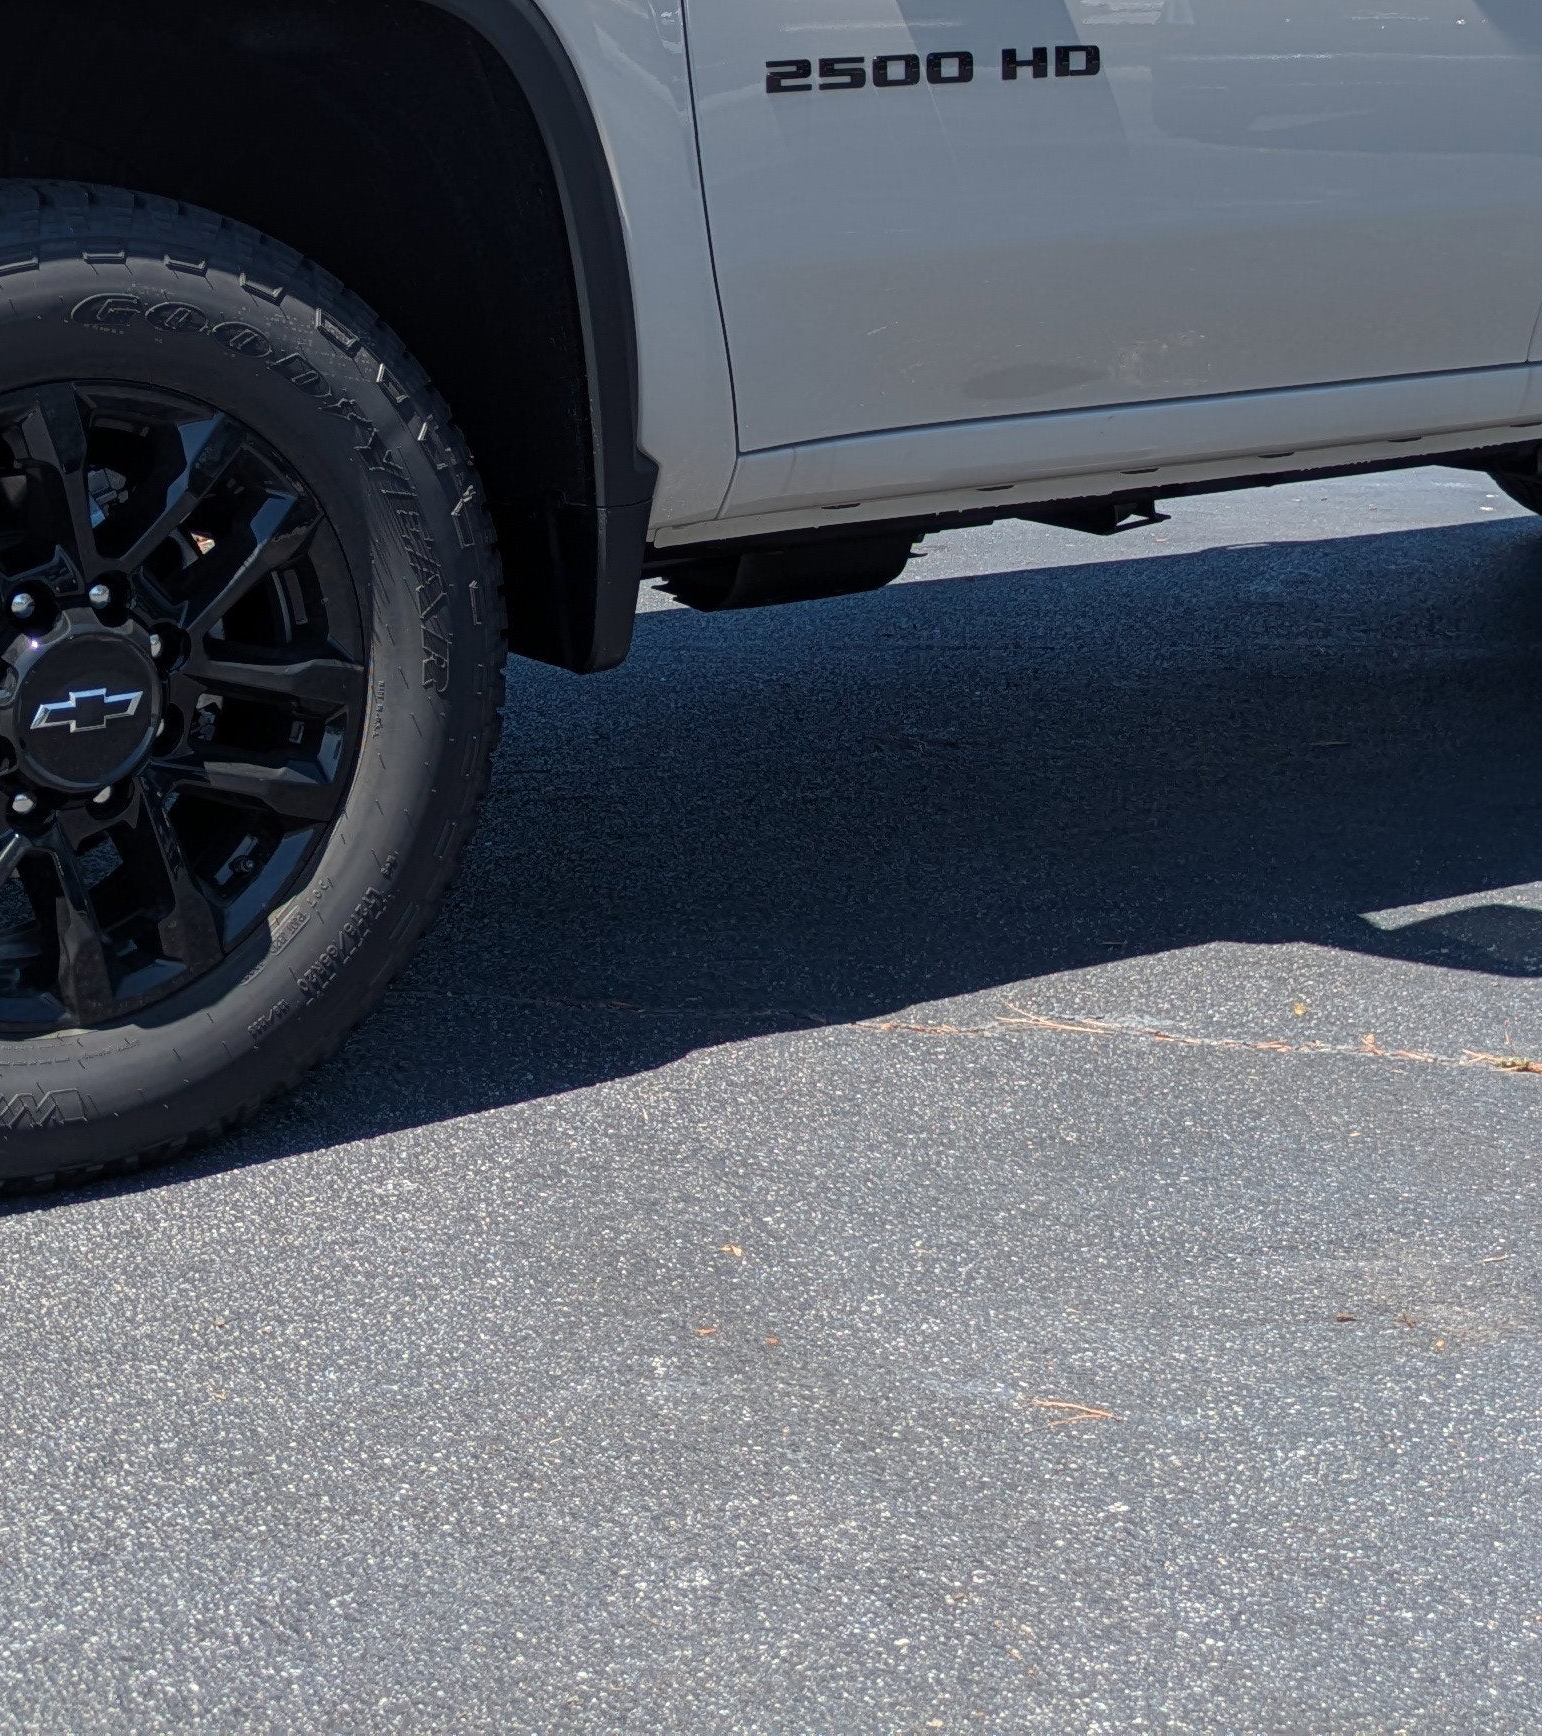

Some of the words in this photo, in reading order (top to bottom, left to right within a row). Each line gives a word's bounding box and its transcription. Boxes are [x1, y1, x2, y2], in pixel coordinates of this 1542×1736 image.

[765, 51, 974, 93] 2500
[1001, 45, 1101, 80] HD
[71, 292, 452, 694] GOODYEAR
